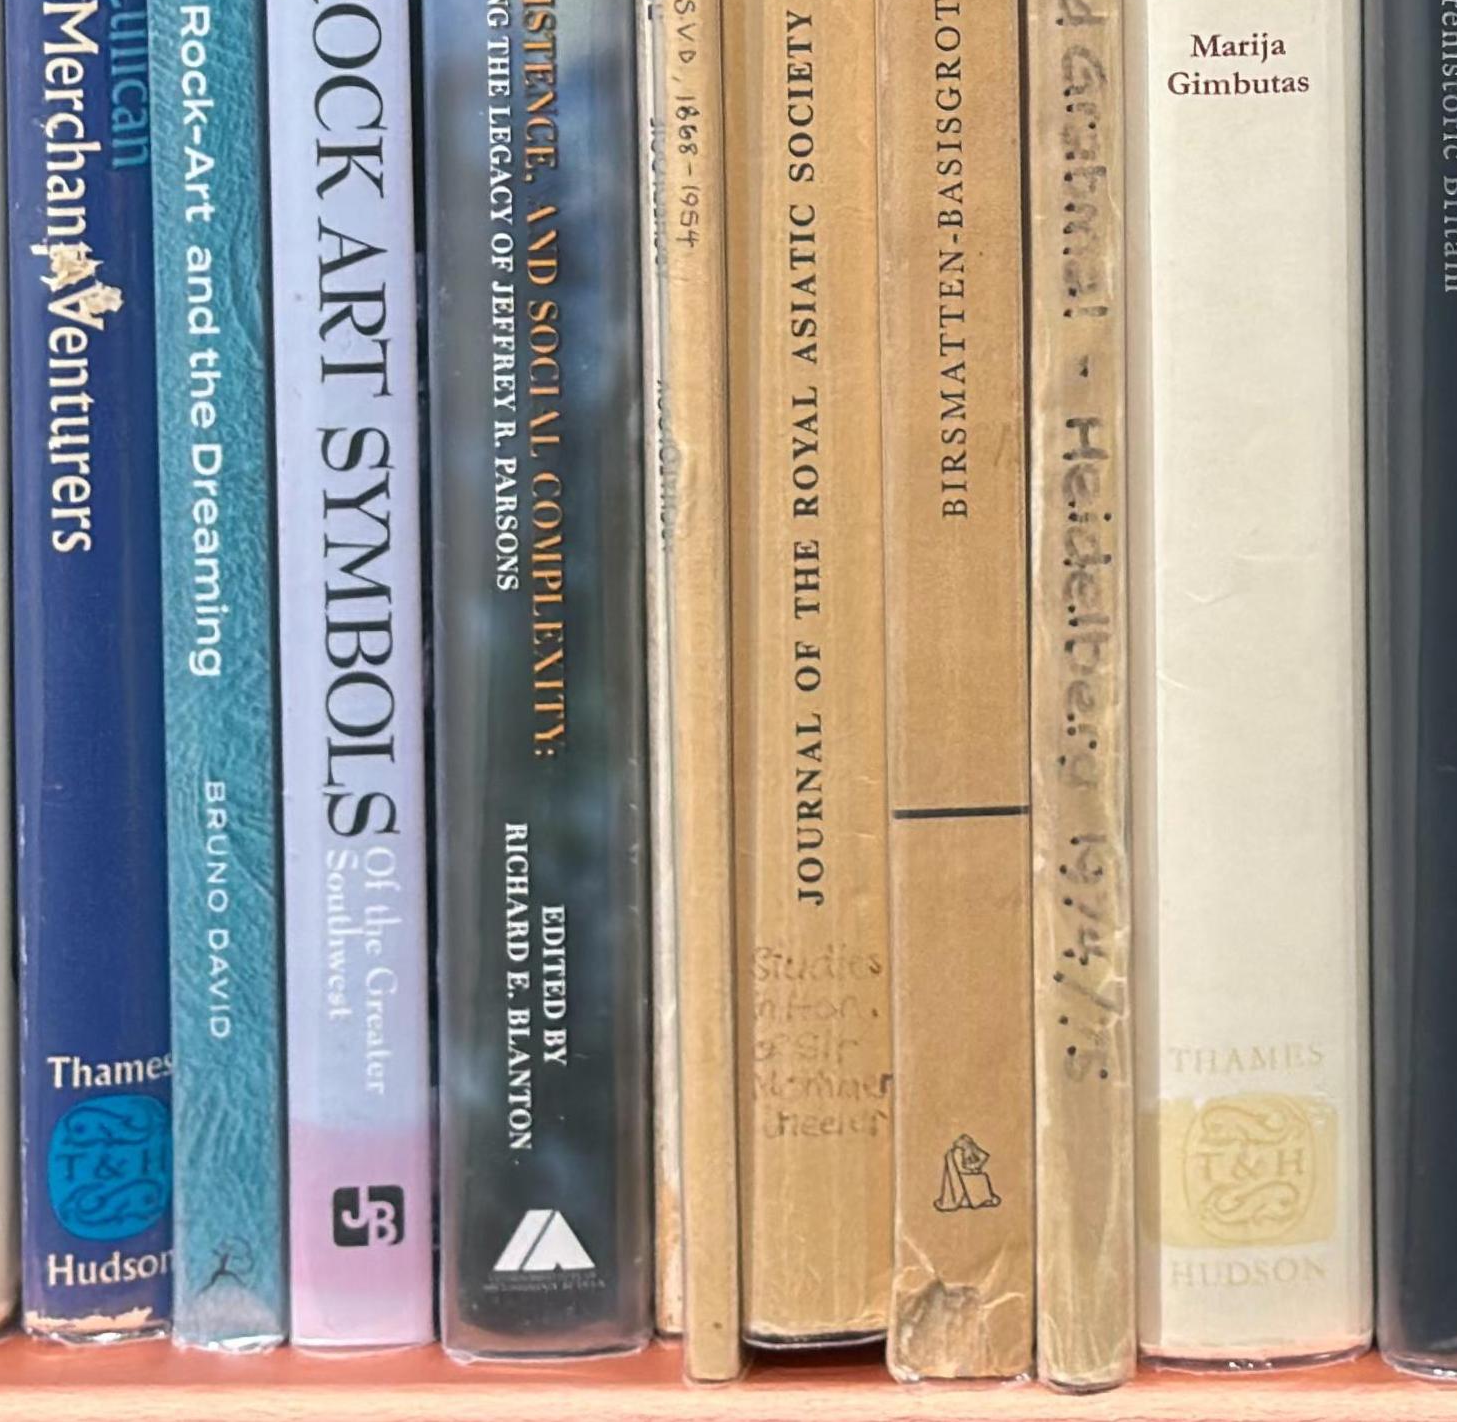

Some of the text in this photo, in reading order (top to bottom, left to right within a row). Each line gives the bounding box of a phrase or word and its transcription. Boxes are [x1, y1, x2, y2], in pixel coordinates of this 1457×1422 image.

[486, 36, 512, 99] THE
[786, 8, 816, 184] SOCIETY
[1166, 71, 1311, 96] Gimbutas
[1188, 32, 1288, 61] Marija
[179, 5, 216, 224] Rock-Art
[488, 105, 516, 225] LEGACY
[185, 246, 220, 337] and
[316, 216, 393, 398] ART
[490, 232, 516, 274] OF
[524, 204, 561, 285] AND
[788, 202, 819, 366] ASIATIC
[188, 346, 223, 429] the
[490, 282, 518, 412] JEFFREY
[525, 298, 562, 459] SOCIAL
[492, 419, 517, 451] R.
[791, 385, 821, 519] ROYAL
[188, 442, 230, 678] Dreaming
[493, 456, 521, 593] PARSONS
[792, 538, 822, 619] THE
[316, 425, 402, 837] SYMBOLS
[529, 470, 567, 758] COMPLEXITY:
[793, 639, 823, 693] OF
[794, 711, 825, 907] JOURNAL
[203, 780, 232, 1040] BRUNO DAVID
[503, 821, 534, 1152] RICHARD E. BLANTON
[540, 903, 569, 1068] EDITED BY
